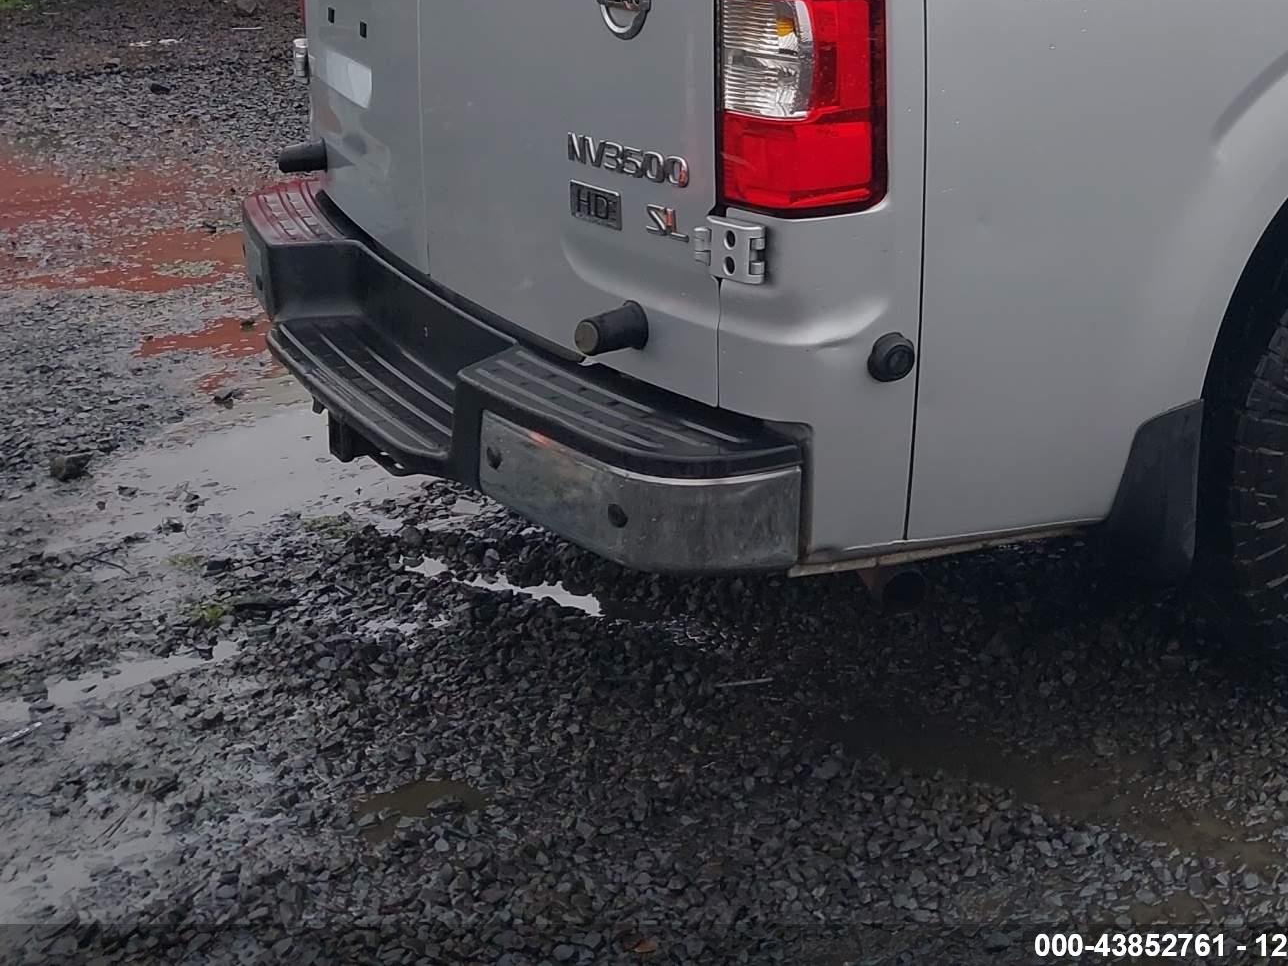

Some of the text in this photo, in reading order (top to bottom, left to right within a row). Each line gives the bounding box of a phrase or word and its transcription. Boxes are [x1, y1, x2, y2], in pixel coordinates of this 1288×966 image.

[567, 132, 689, 187] NV3500
[576, 188, 609, 220] HD
[646, 203, 689, 243] SL
